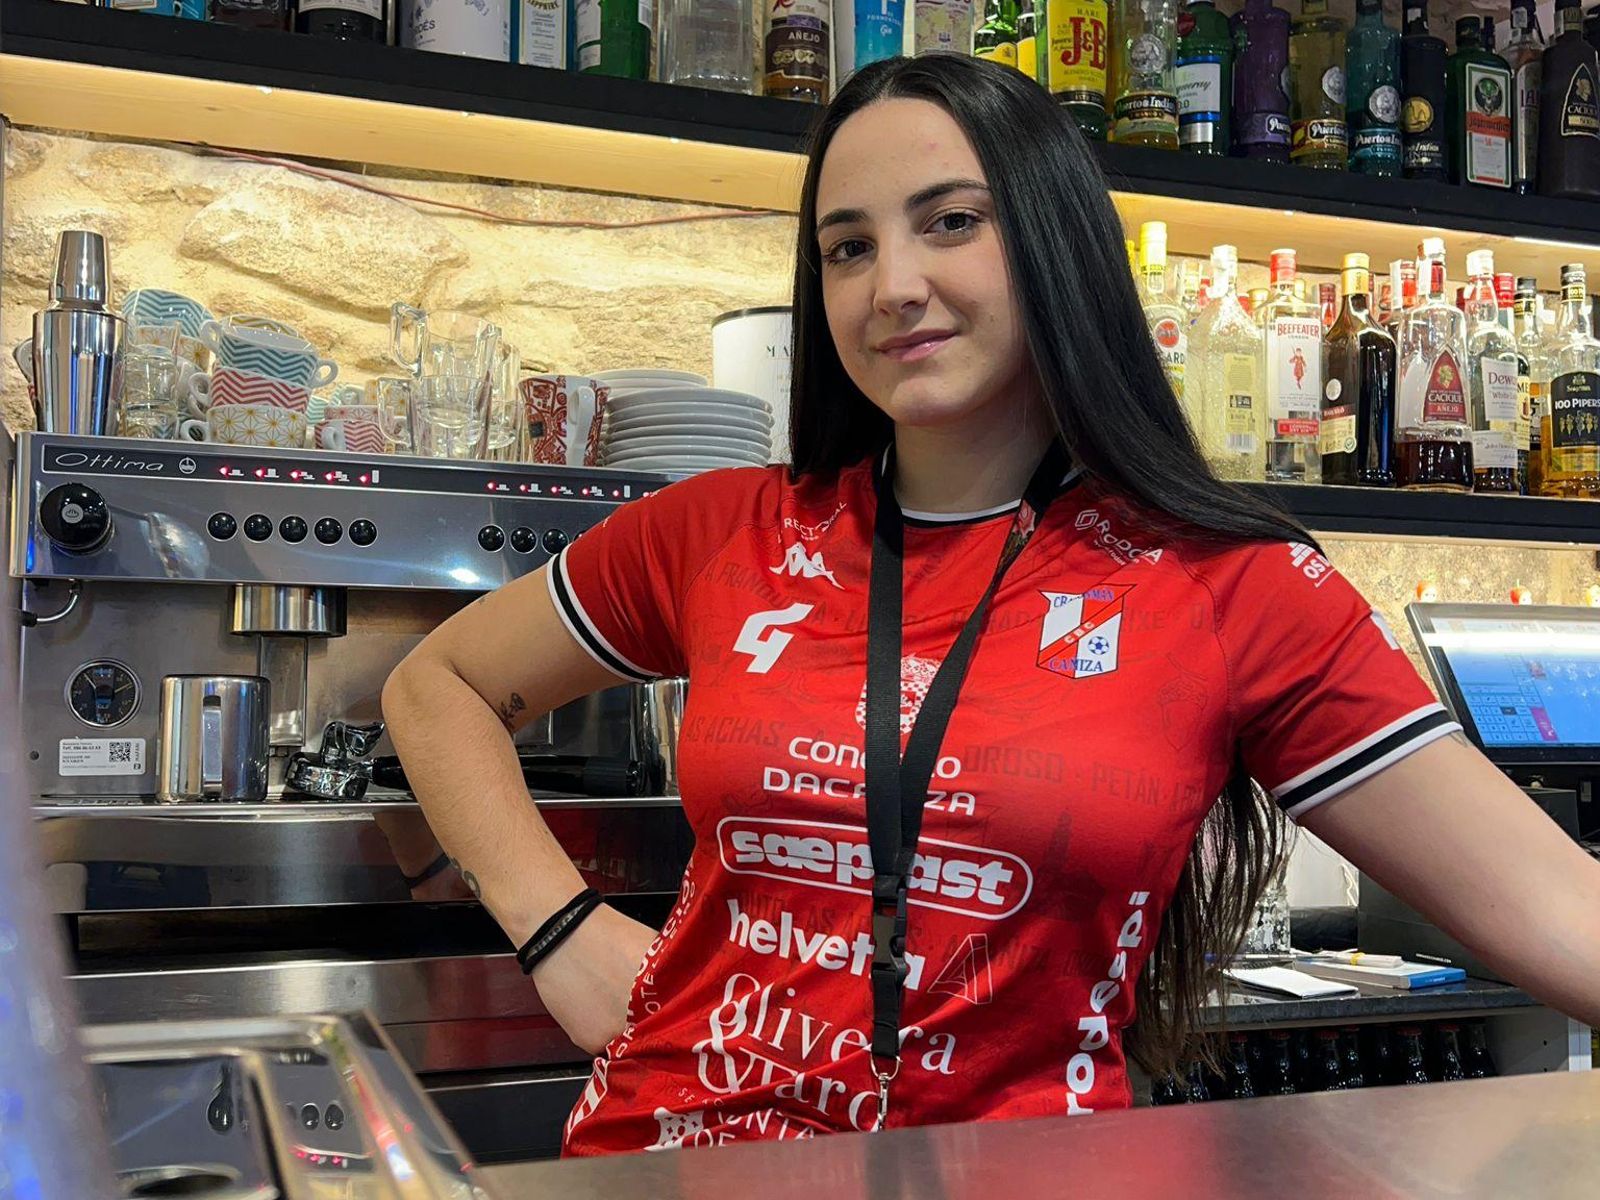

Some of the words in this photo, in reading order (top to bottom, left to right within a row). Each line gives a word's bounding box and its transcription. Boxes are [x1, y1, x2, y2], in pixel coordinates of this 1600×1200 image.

[788, 31, 821, 43] AÑEJO
[1061, 16, 1106, 71] J&B
[1277, 323, 1320, 338] BEEFEATER
[1554, 399, 1571, 410] 100
[55, 452, 165, 473] Ottima
[731, 830, 1013, 905] saepast
[727, 898, 926, 991] helveta
